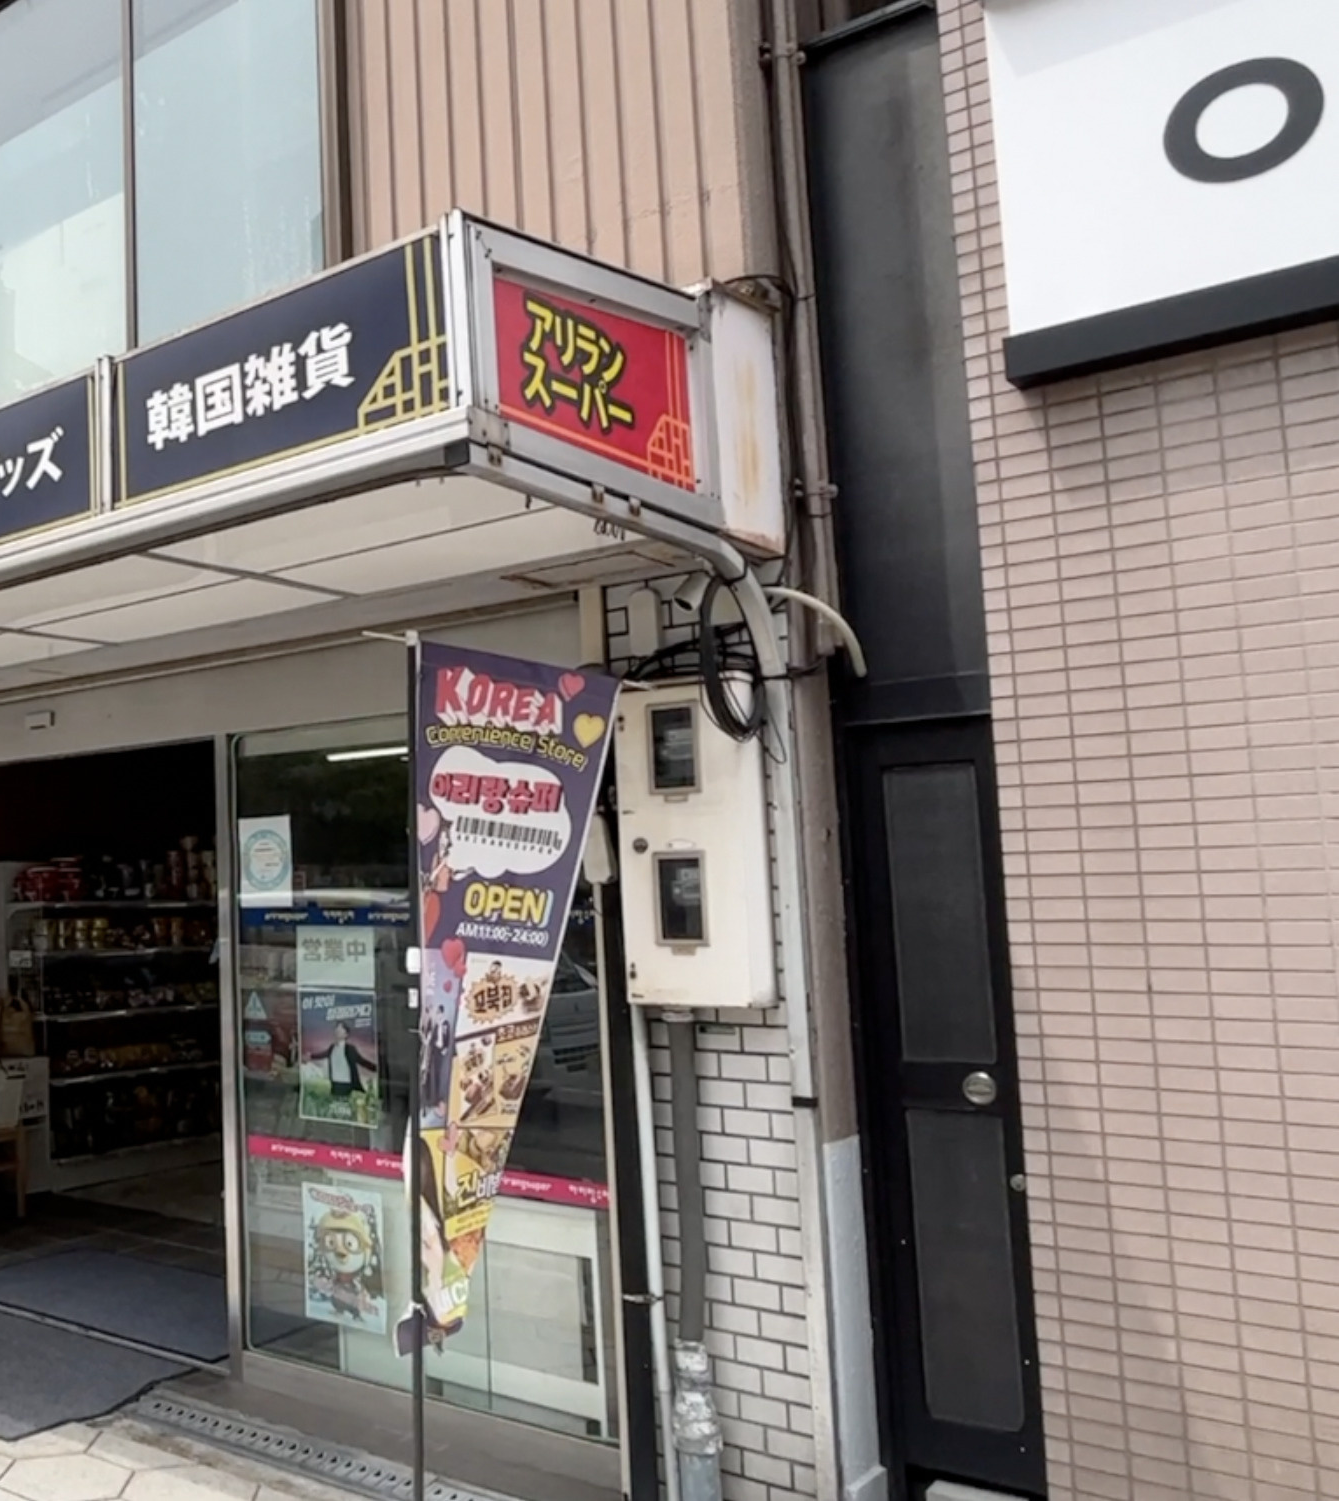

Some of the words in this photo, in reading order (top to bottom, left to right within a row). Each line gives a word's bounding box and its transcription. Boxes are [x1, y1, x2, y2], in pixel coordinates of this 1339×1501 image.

[526, 299, 624, 384] アリラン
[146, 321, 355, 451] 韓国雑貨
[523, 351, 634, 430] スーパー
[436, 666, 562, 735] KOREA
[426, 723, 535, 753] Convenience
[432, 772, 563, 815] 아리랑슈퍼
[463, 881, 553, 928] OPEN
[302, 938, 367, 962] 営業中
